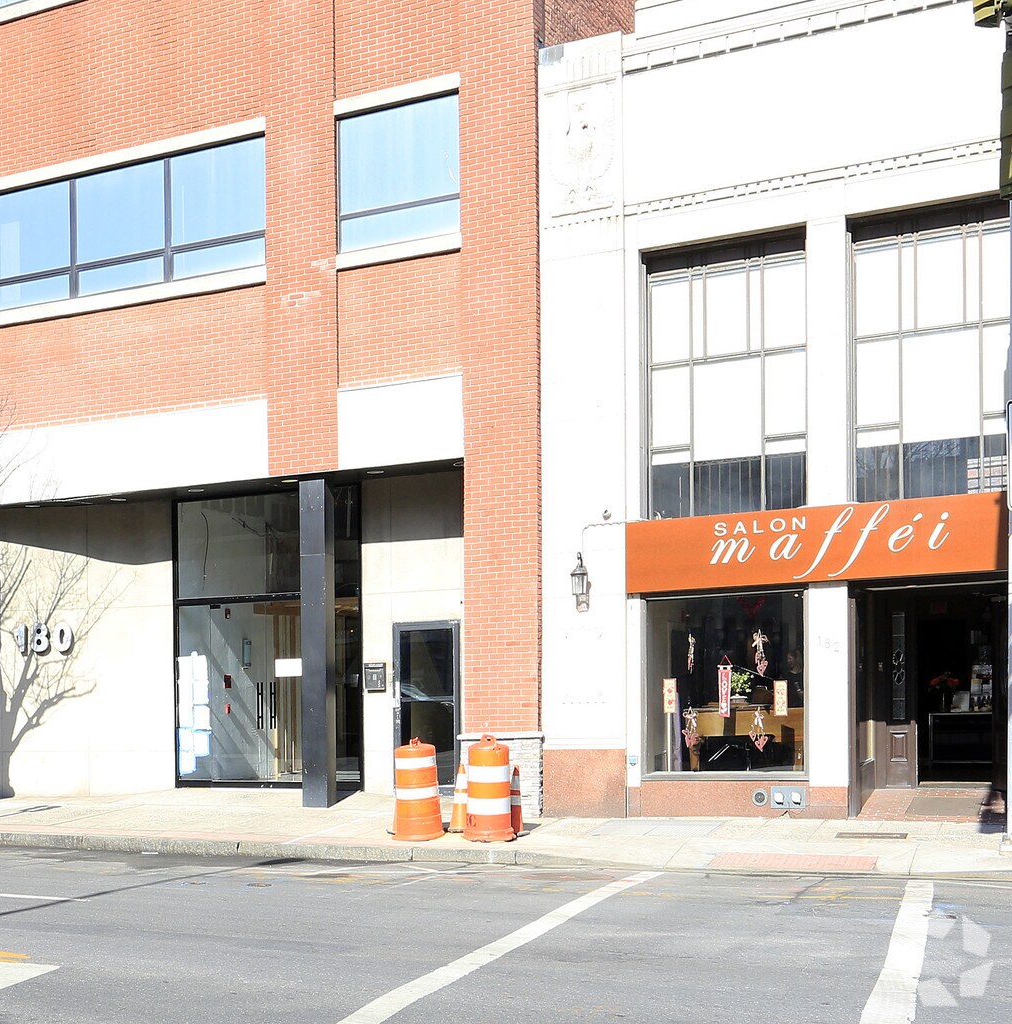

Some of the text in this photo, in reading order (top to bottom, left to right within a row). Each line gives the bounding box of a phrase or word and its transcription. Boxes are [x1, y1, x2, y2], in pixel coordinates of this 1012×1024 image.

[709, 503, 950, 580] mafféi
[713, 516, 807, 537] SALON
[13, 621, 73, 654] 180
